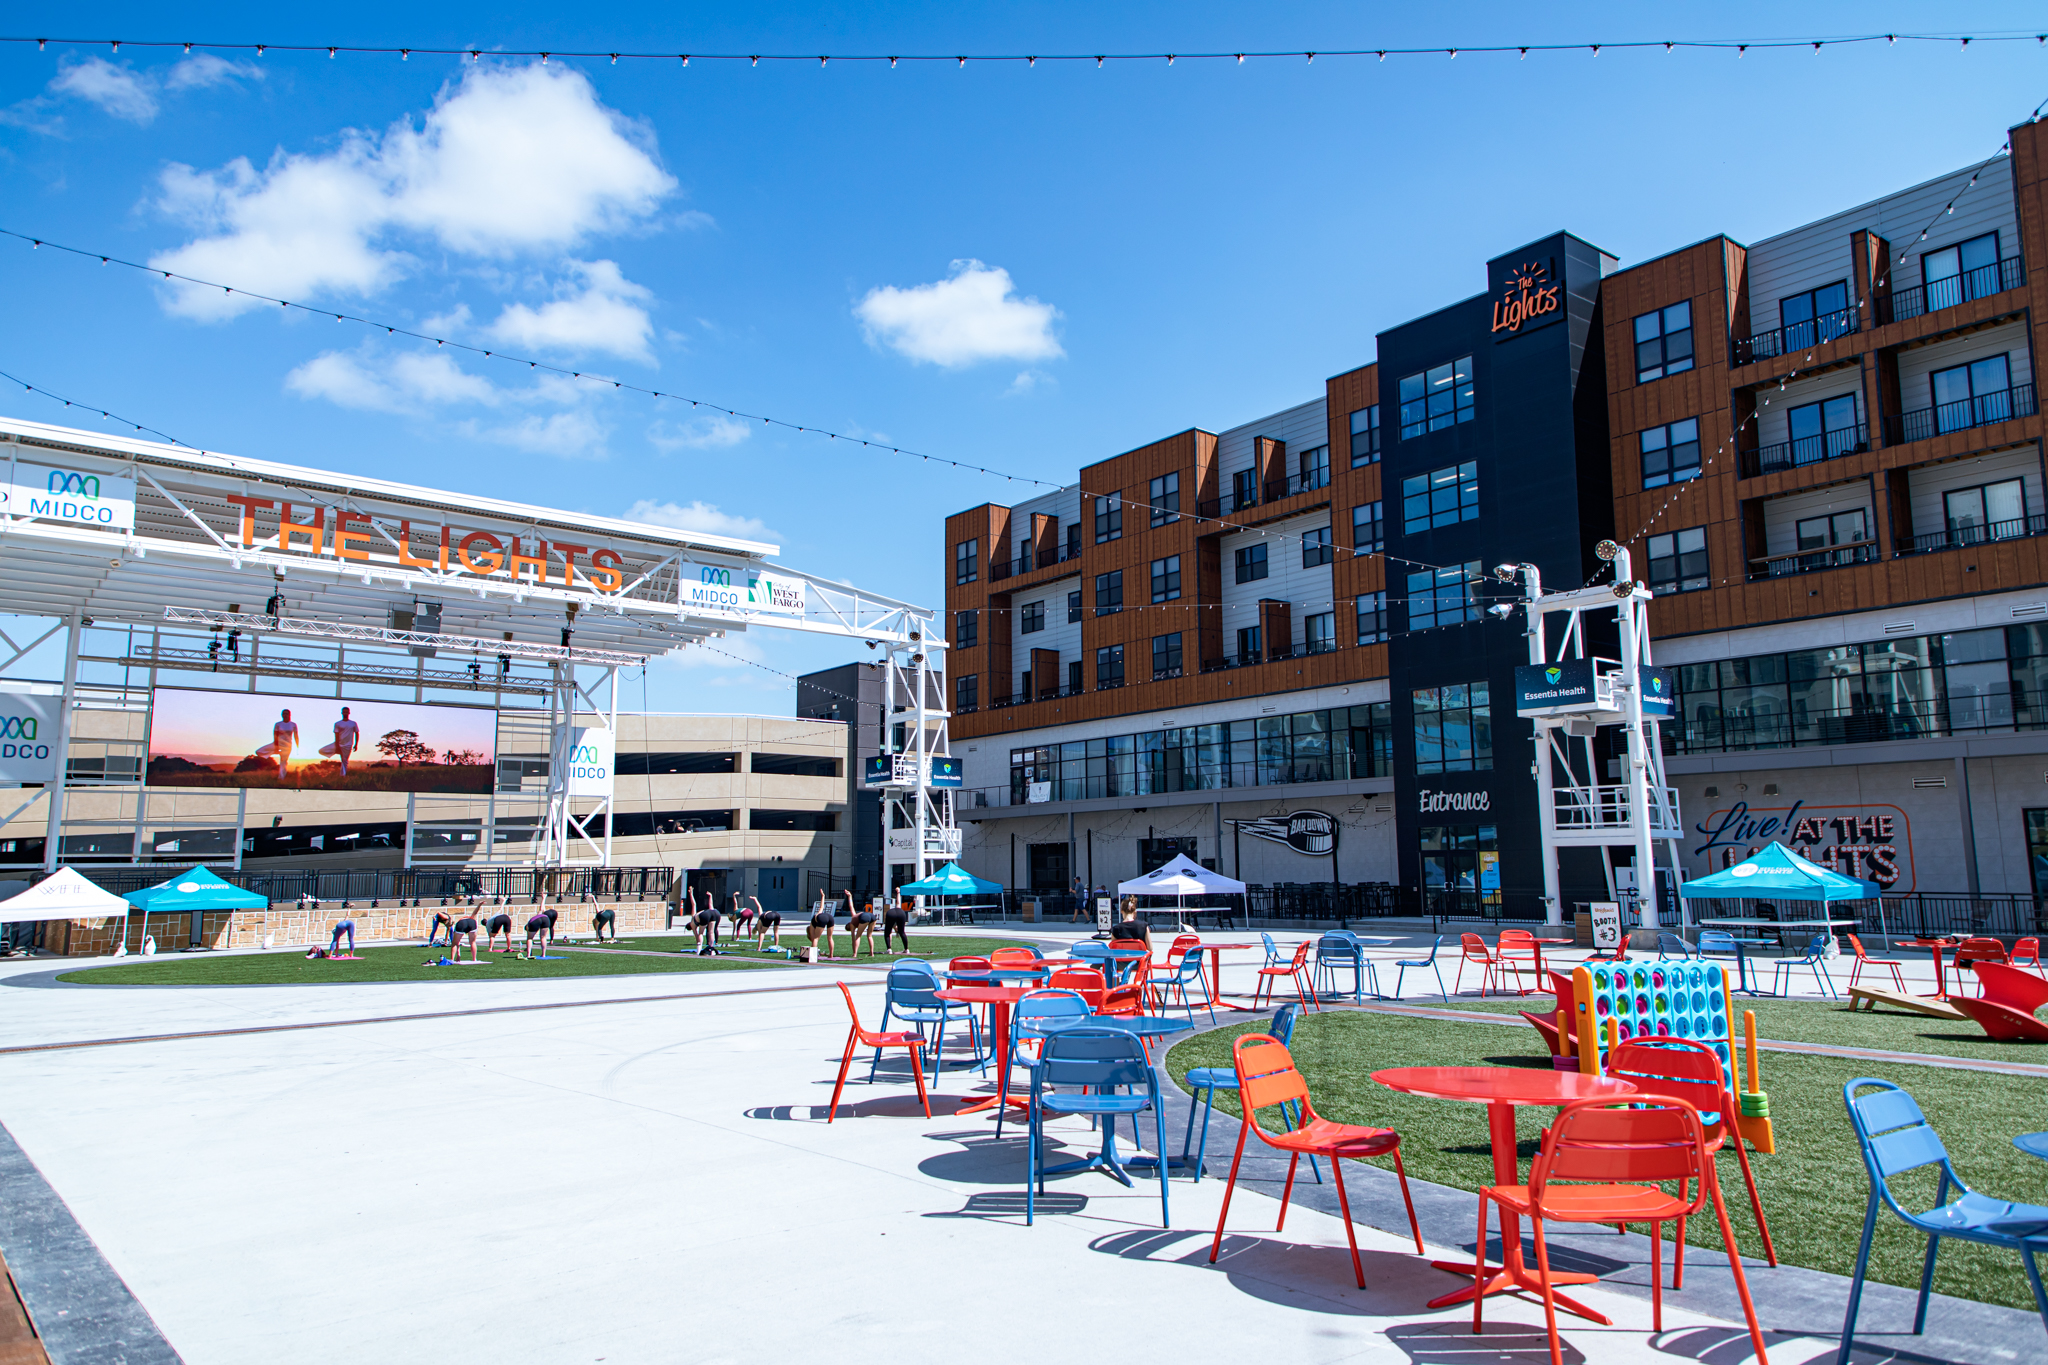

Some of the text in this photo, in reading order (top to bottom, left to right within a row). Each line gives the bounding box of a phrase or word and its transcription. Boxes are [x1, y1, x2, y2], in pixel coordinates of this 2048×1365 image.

[1517, 276, 1533, 290] The
[1491, 286, 1558, 332] Lights
[30, 498, 113, 523] MIDCO
[227, 494, 623, 592] THE LIGHTS
[692, 588, 738, 605] MIDCO
[773, 589, 800, 600] WEST
[773, 597, 804, 609] FARGO
[1524, 686, 1586, 701] Essentia Health
[569, 767, 606, 779] IDCO
[1419, 789, 1490, 813] Entrance
[1290, 818, 1330, 835] BAR DOWN
[1694, 800, 1895, 856] Live! AT THE
[893, 838, 913, 848] Capital
[1593, 916, 1617, 928] BOOTH
[1598, 927, 1617, 942] #3
